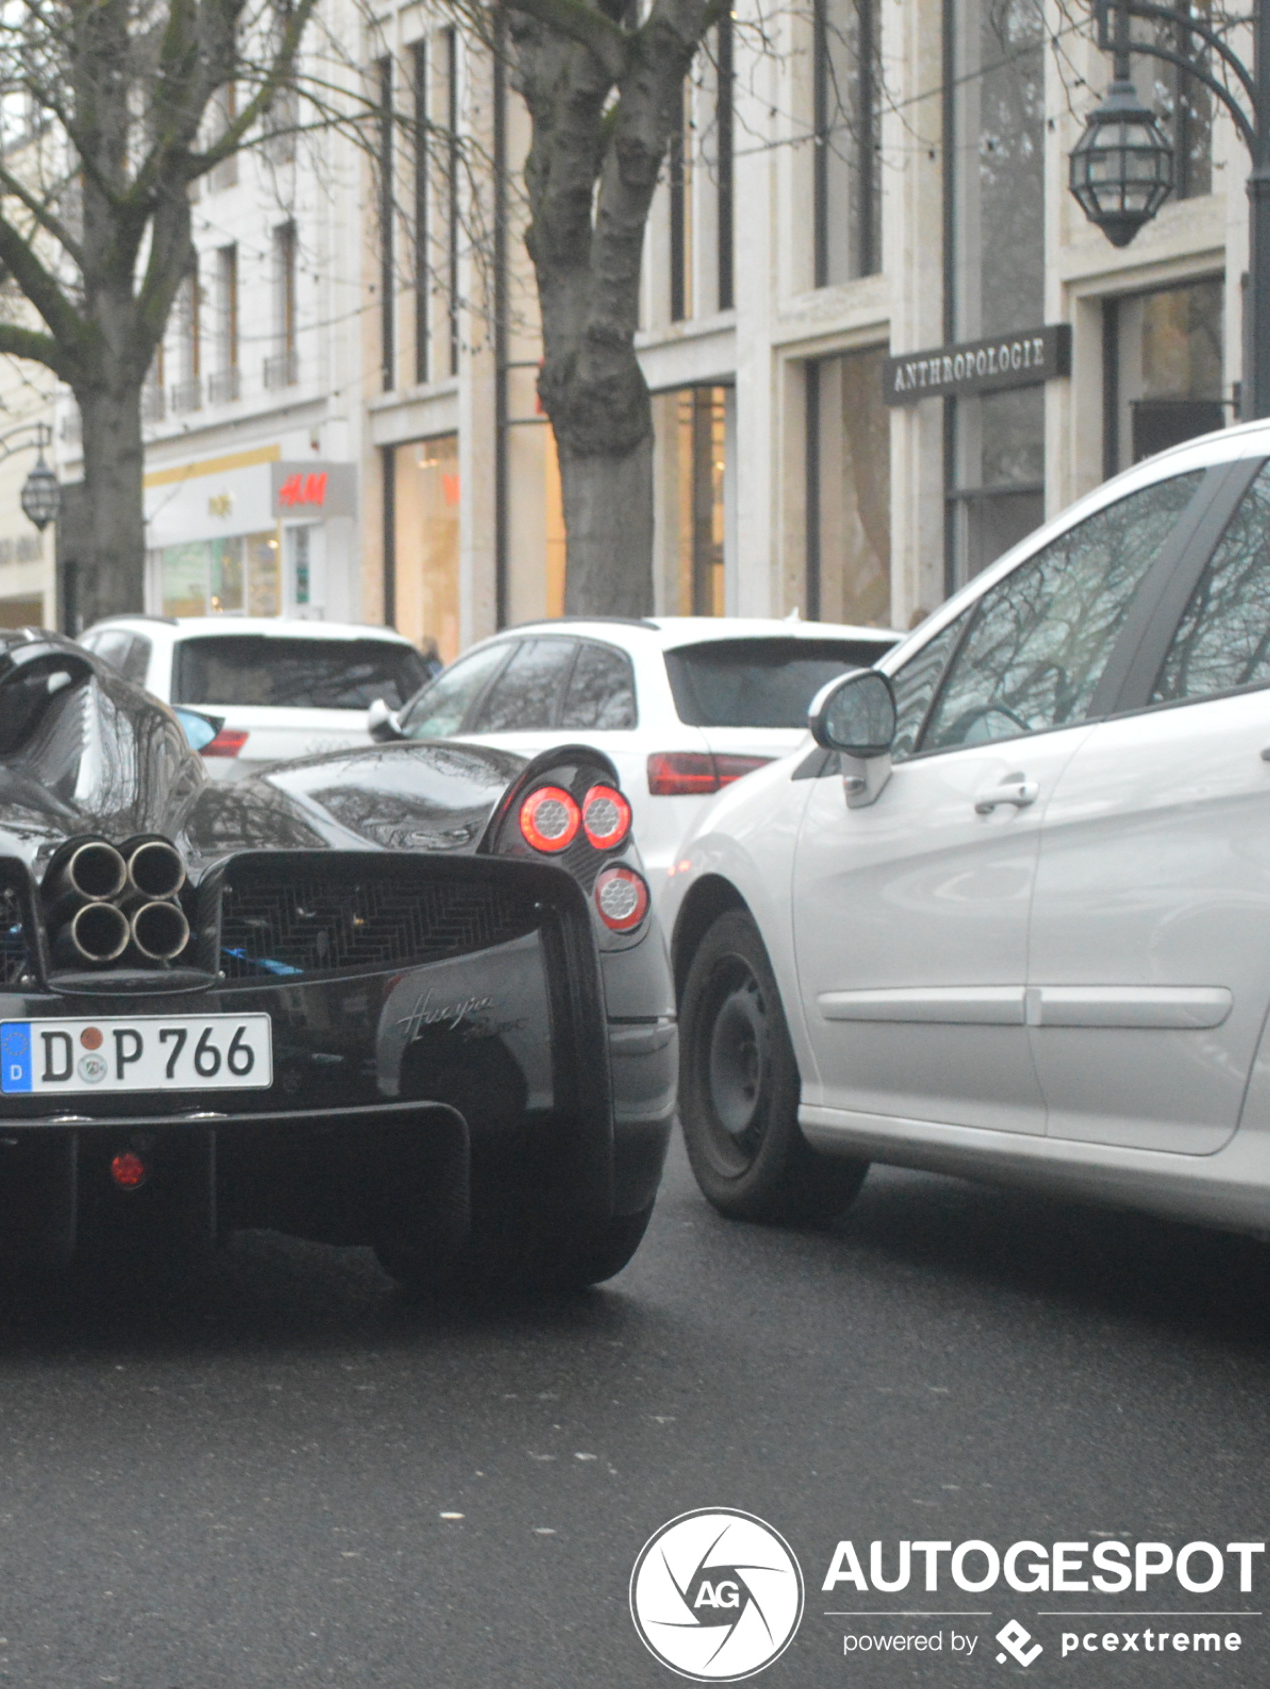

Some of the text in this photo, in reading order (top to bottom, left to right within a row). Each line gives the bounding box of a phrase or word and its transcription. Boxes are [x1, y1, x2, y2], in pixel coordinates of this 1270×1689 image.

[894, 338, 1045, 391] ANTHROPOLOGIE
[10, 1065, 23, 1081] D
[40, 1025, 255, 1082] D P 766
